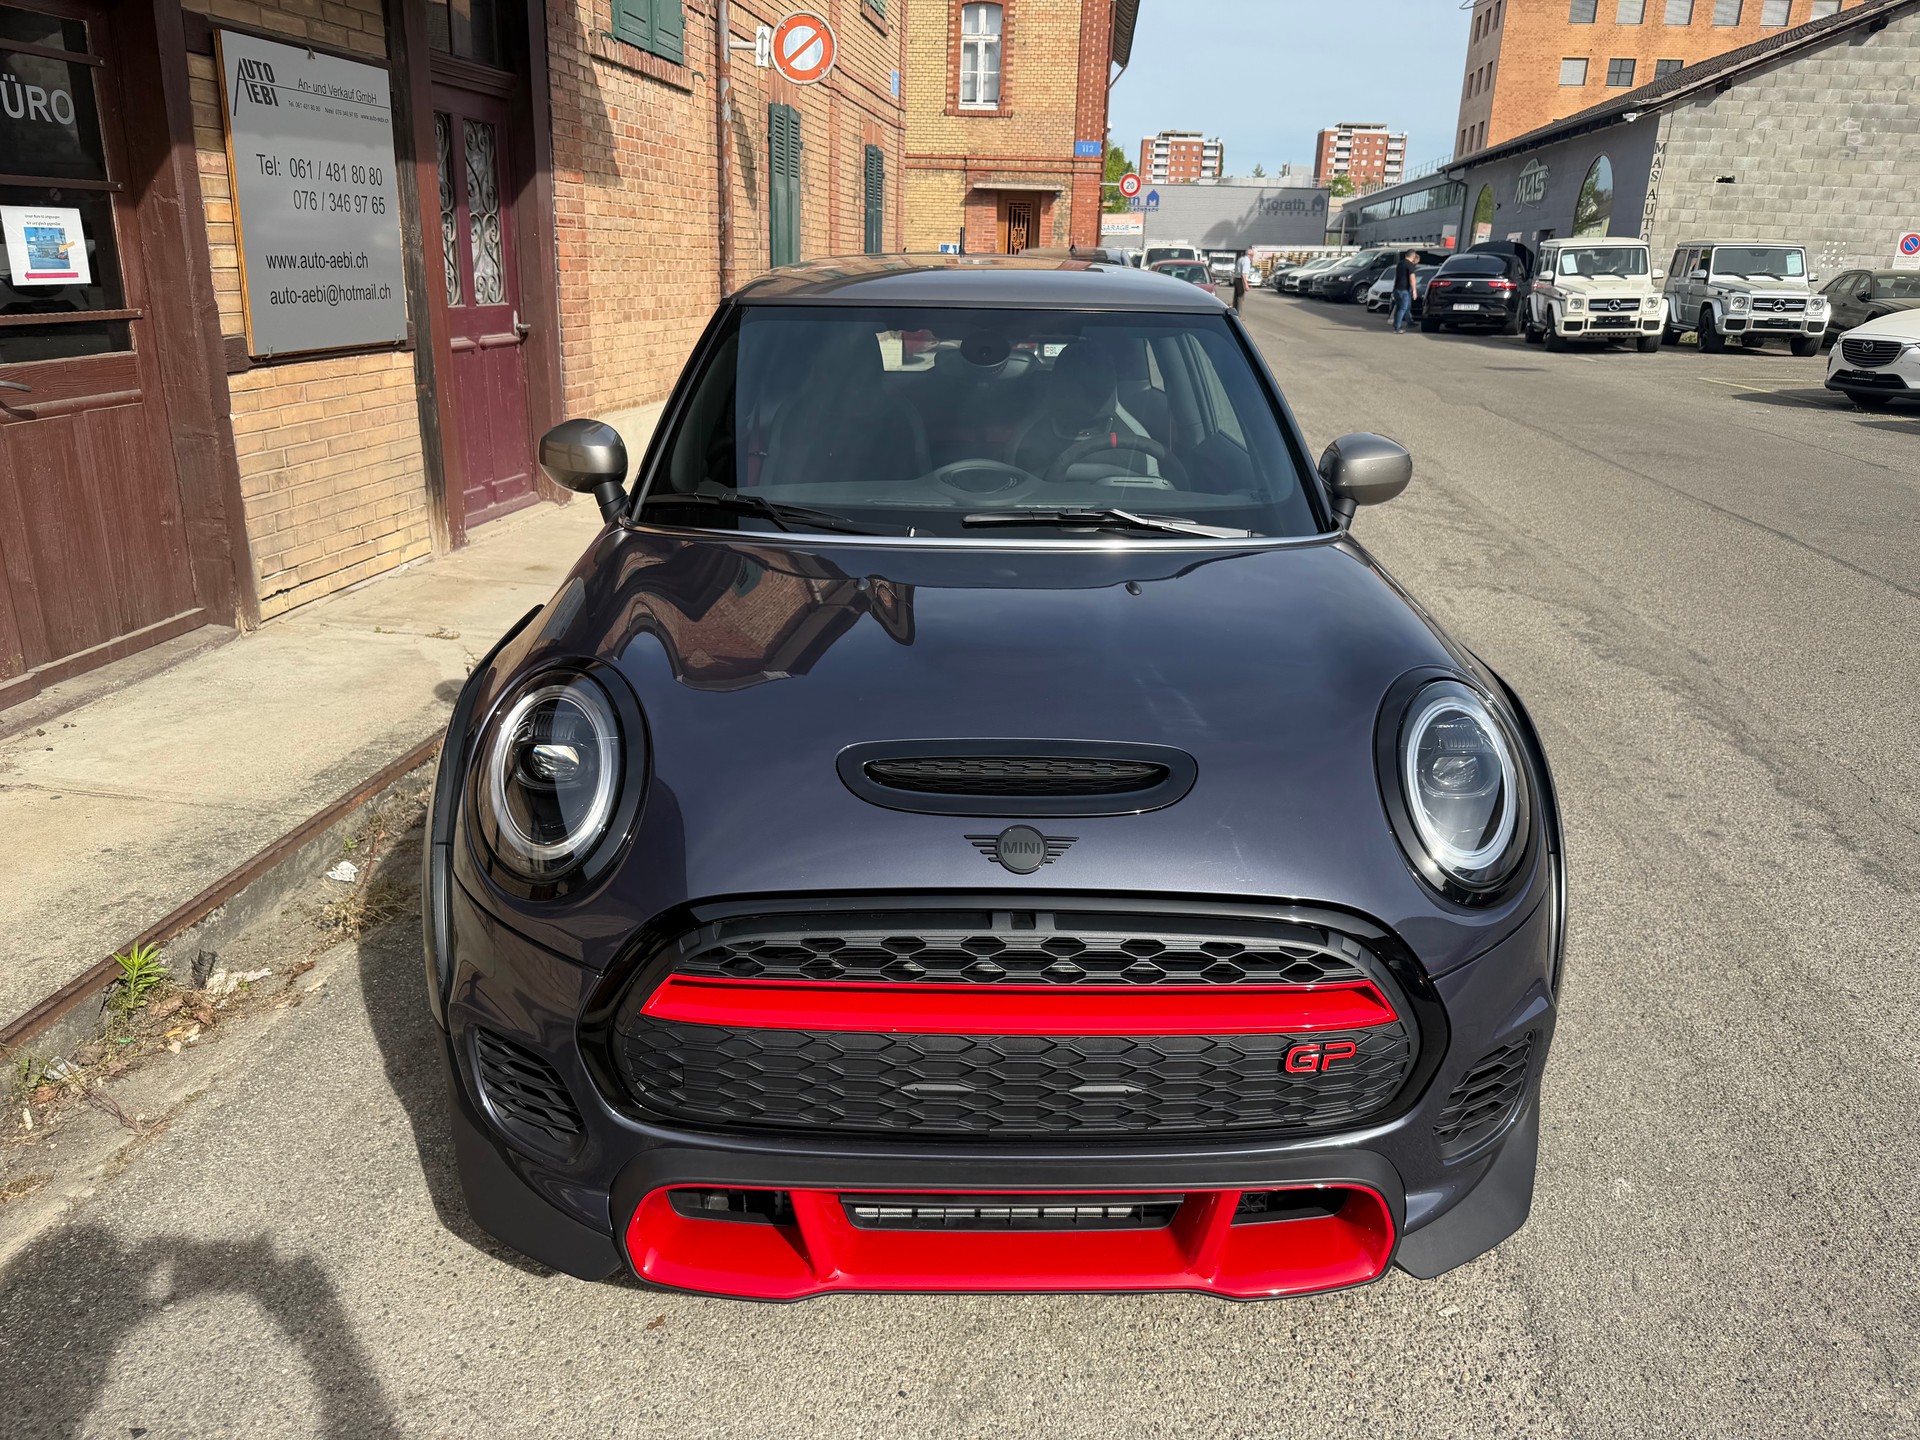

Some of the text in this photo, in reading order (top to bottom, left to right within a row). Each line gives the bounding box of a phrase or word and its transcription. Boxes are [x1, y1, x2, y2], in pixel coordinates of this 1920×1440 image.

[298, 78, 377, 104] An- und Verkauf GmbH
[1082, 144, 1094, 153] 112
[256, 153, 282, 177] Tel:
[290, 157, 313, 179] 061
[325, 162, 347, 182] 481
[351, 165, 366, 184] 80
[369, 167, 383, 186] 80
[1650, 142, 1667, 182] MAS
[1126, 181, 1136, 190] 20
[293, 189, 317, 210] 076
[329, 192, 351, 213] 346
[354, 194, 368, 213] 97
[371, 196, 386, 214] 65
[265, 251, 369, 269] www.auto-aebi.ch
[270, 283, 391, 307] auto-aebi@hotmail.ch
[1003, 841, 1041, 854] MINI
[1285, 1041, 1357, 1074] GP
